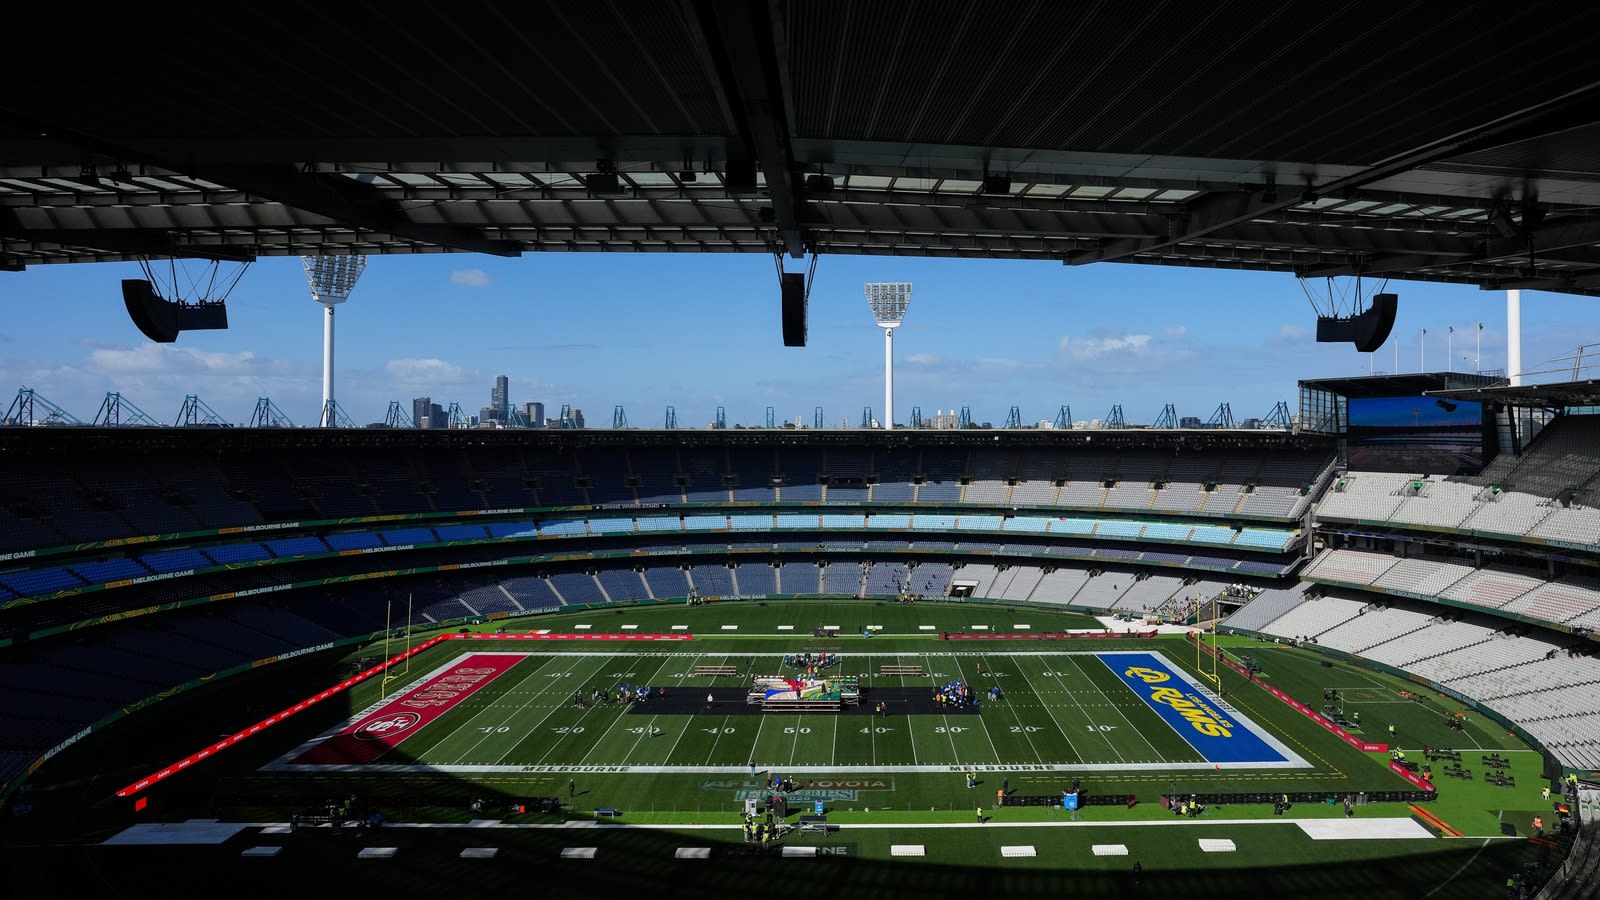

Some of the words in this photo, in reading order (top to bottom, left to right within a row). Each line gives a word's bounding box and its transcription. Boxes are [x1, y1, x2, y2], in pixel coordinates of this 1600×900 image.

[328, 307, 334, 315] 3
[244, 523, 281, 532] MELBOURNE
[282, 521, 299, 529] GAME
[13, 549, 36, 559] GAME
[363, 545, 397, 554] MELBOURNE
[460, 561, 492, 569] MELBOURNE
[133, 573, 174, 585] MELBOURNE
[175, 569, 194, 578] GAME
[235, 586, 273, 597] MELBOURNE
[274, 583, 292, 592] GAME
[509, 608, 542, 617] MELBOURNE
[278, 647, 315, 662] MELBOURNE
[315, 641, 334, 652] GAME
[1150, 686, 1232, 738] RAMS
[557, 726, 585, 734] 20
[807, 780, 887, 788] TOYOTA
